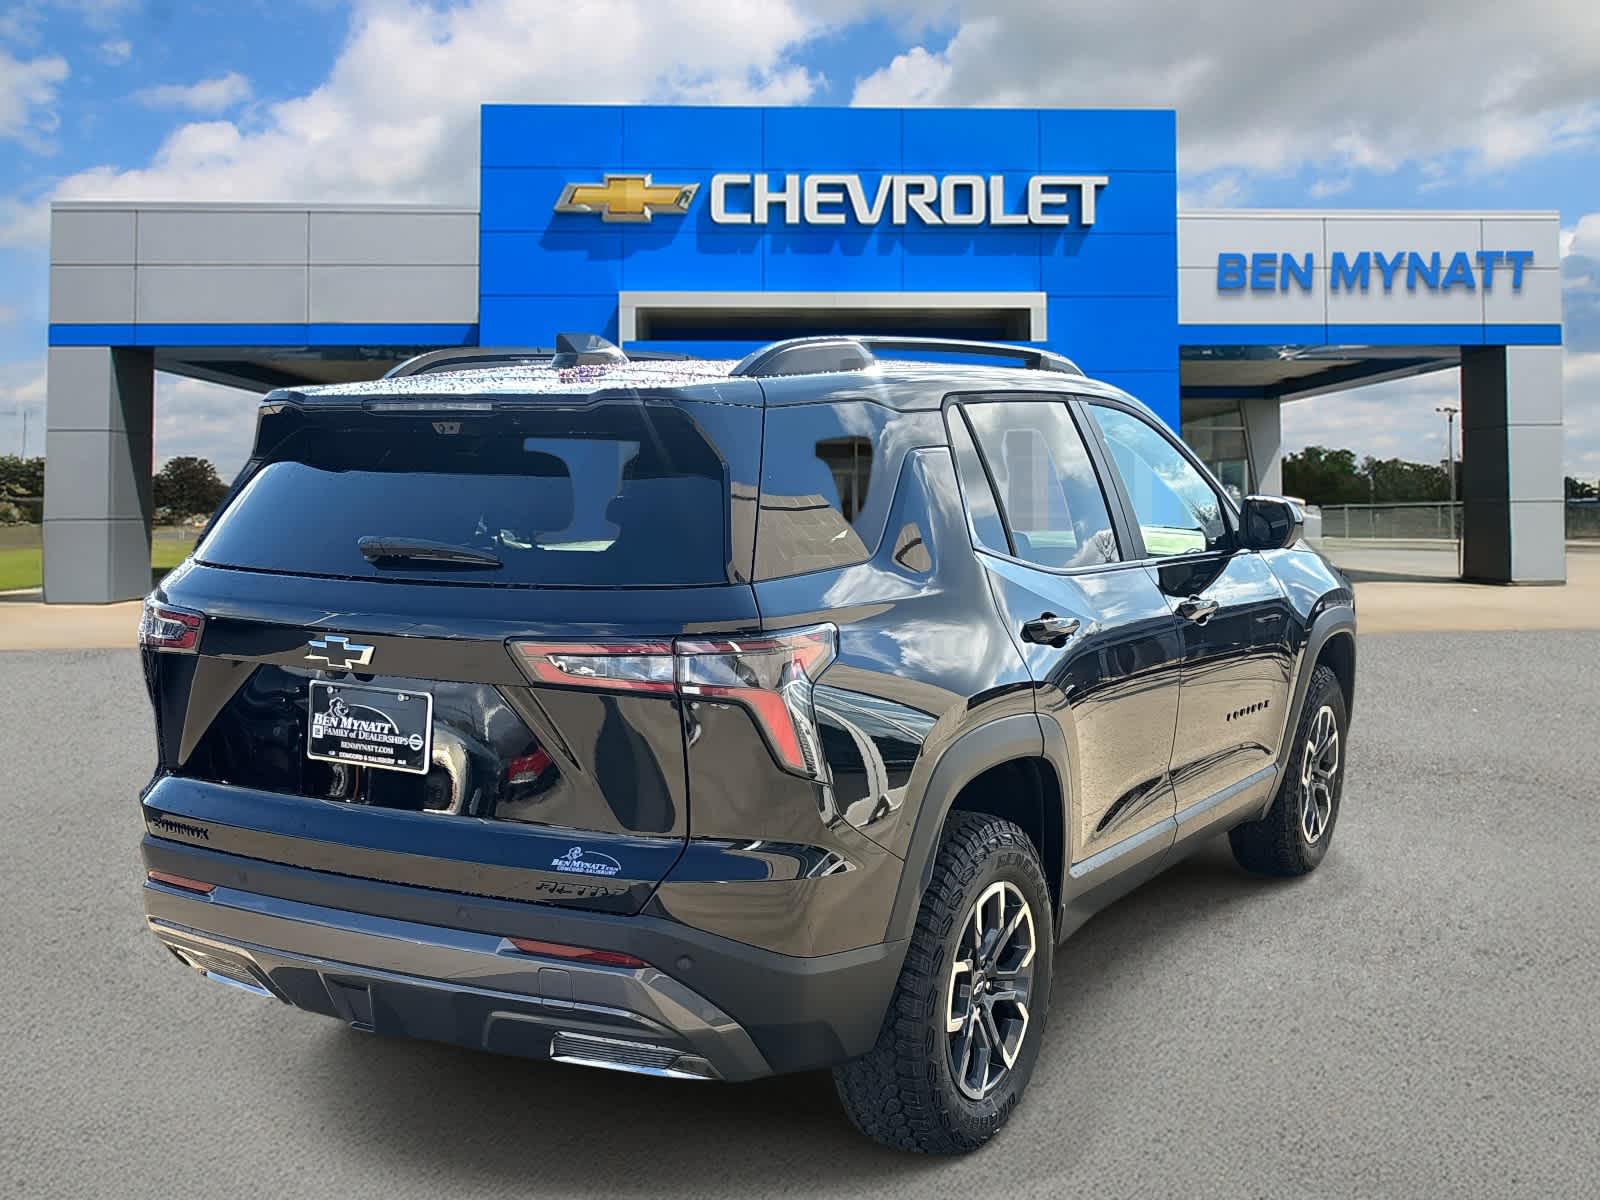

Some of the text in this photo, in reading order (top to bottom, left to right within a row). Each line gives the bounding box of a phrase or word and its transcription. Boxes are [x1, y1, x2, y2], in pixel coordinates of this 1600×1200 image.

[710, 173, 1109, 225] CHEVROLET
[1217, 250, 1534, 291] BEN MYNATT
[313, 713, 339, 727] BEN
[340, 716, 392, 734] MYNATT
[323, 727, 349, 738] FAMILY
[349, 731, 357, 739] of
[358, 730, 409, 746] DEALERSHIPS
[340, 741, 394, 755] BENMYNATT.COM
[551, 858, 572, 867] BEN
